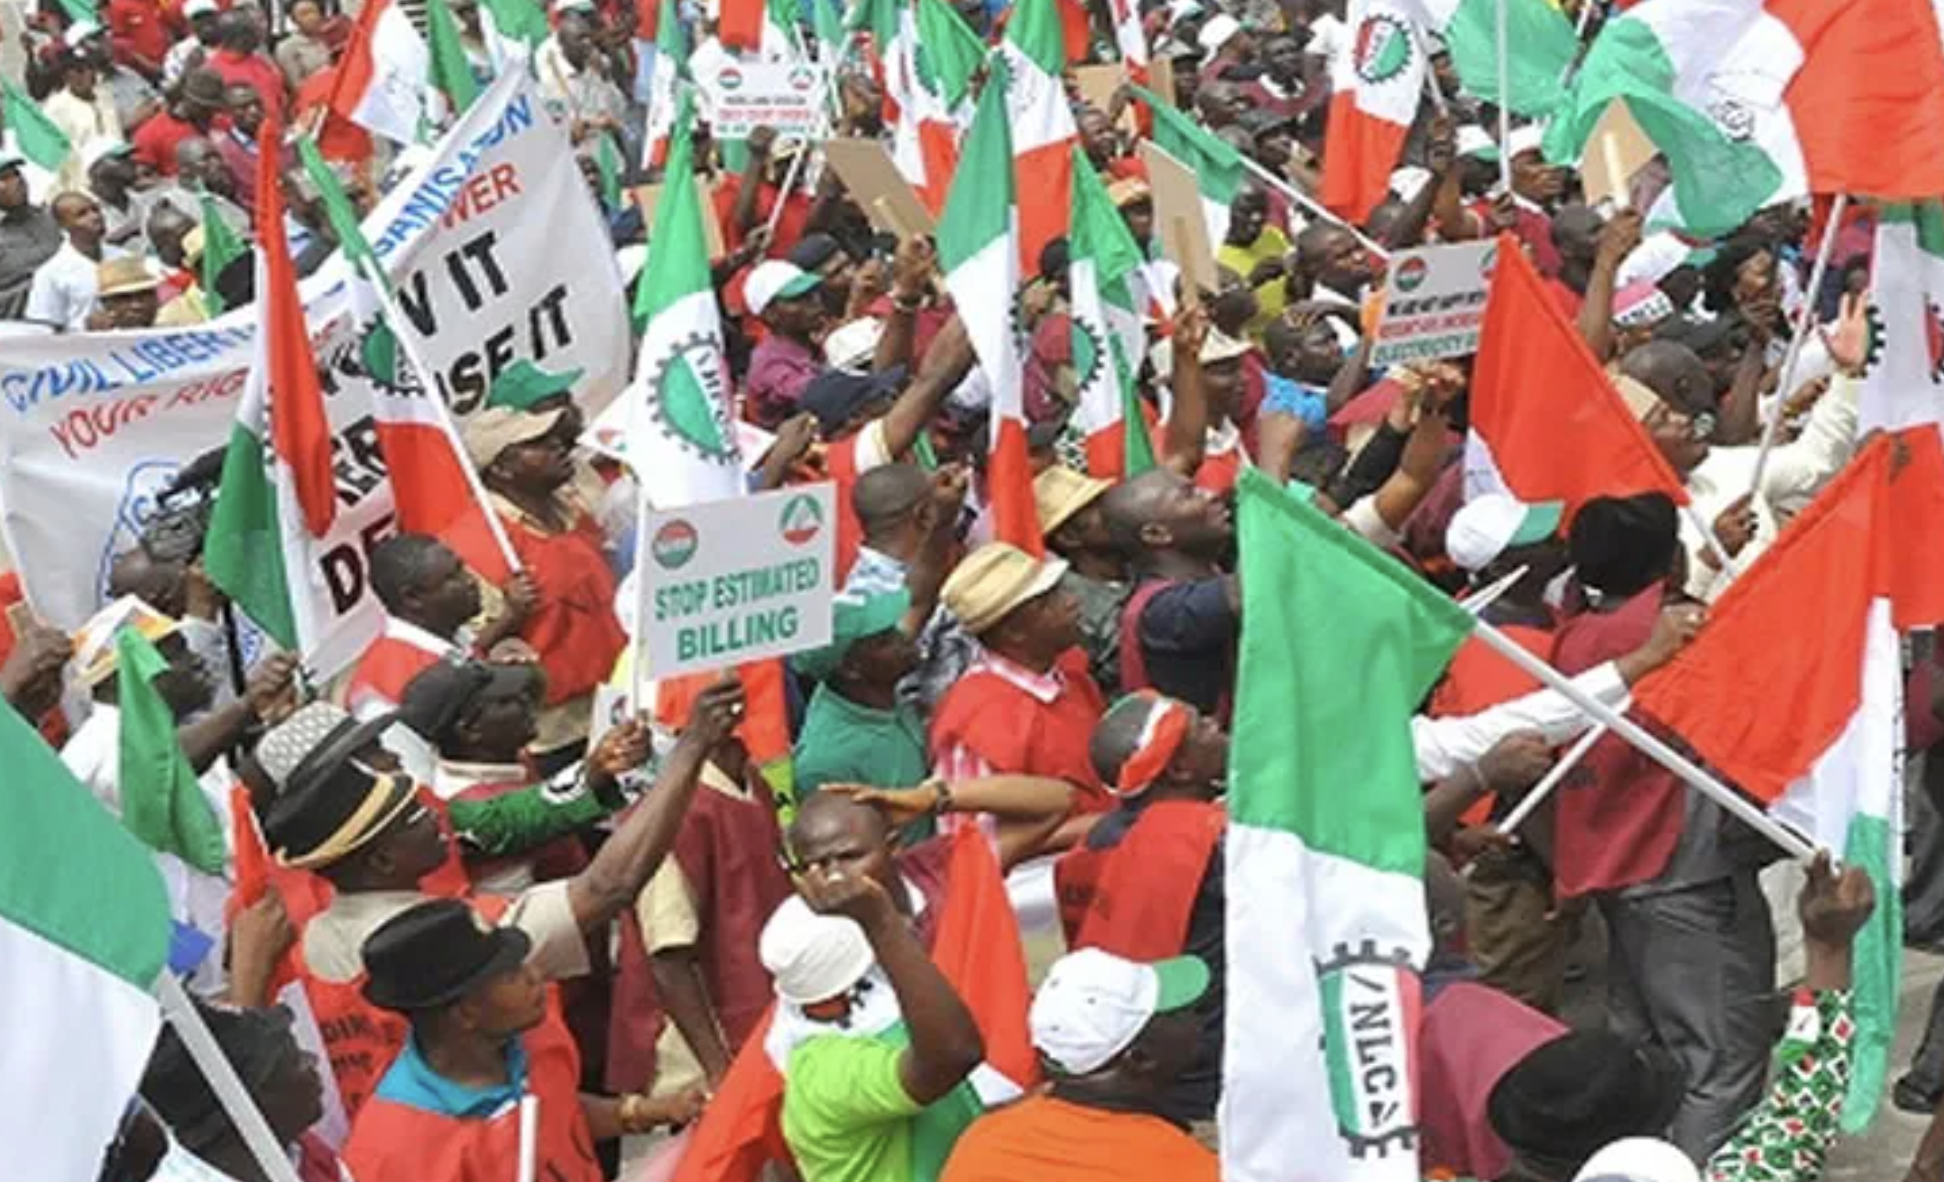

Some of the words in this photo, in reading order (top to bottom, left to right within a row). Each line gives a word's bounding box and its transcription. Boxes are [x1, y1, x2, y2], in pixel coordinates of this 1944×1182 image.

[445, 230, 508, 312] IT
[529, 284, 571, 361] IT
[49, 394, 158, 459] YOUR
[655, 579, 707, 621] STOP
[713, 556, 820, 609] ESTIMATED
[678, 605, 798, 661] BILLING
[1350, 1001, 1398, 1095] NLC
